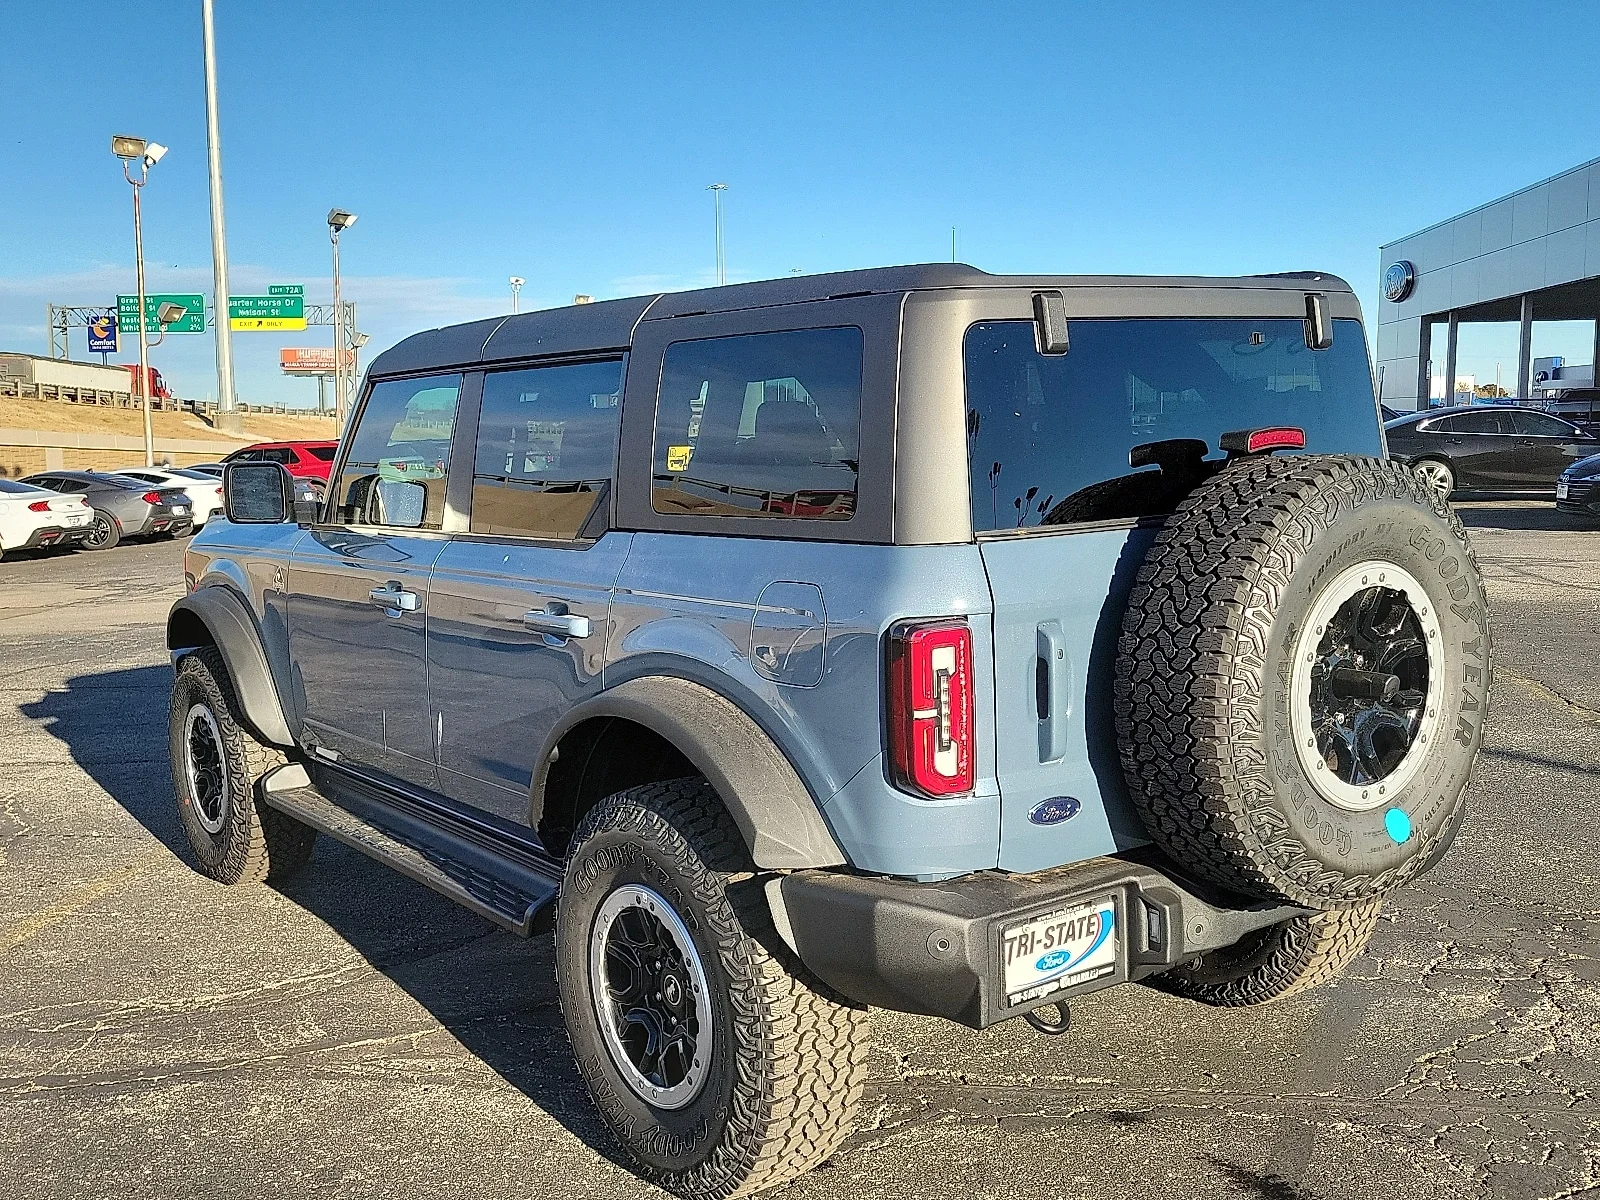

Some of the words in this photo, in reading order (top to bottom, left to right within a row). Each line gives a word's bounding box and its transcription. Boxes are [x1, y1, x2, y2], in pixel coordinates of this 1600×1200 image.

[285, 286, 300, 294] 72A
[229, 299, 253, 307] uarter
[238, 308, 267, 316] Nelson
[1004, 913, 1098, 968] TRI-STATE
[1042, 953, 1067, 971] Ford
